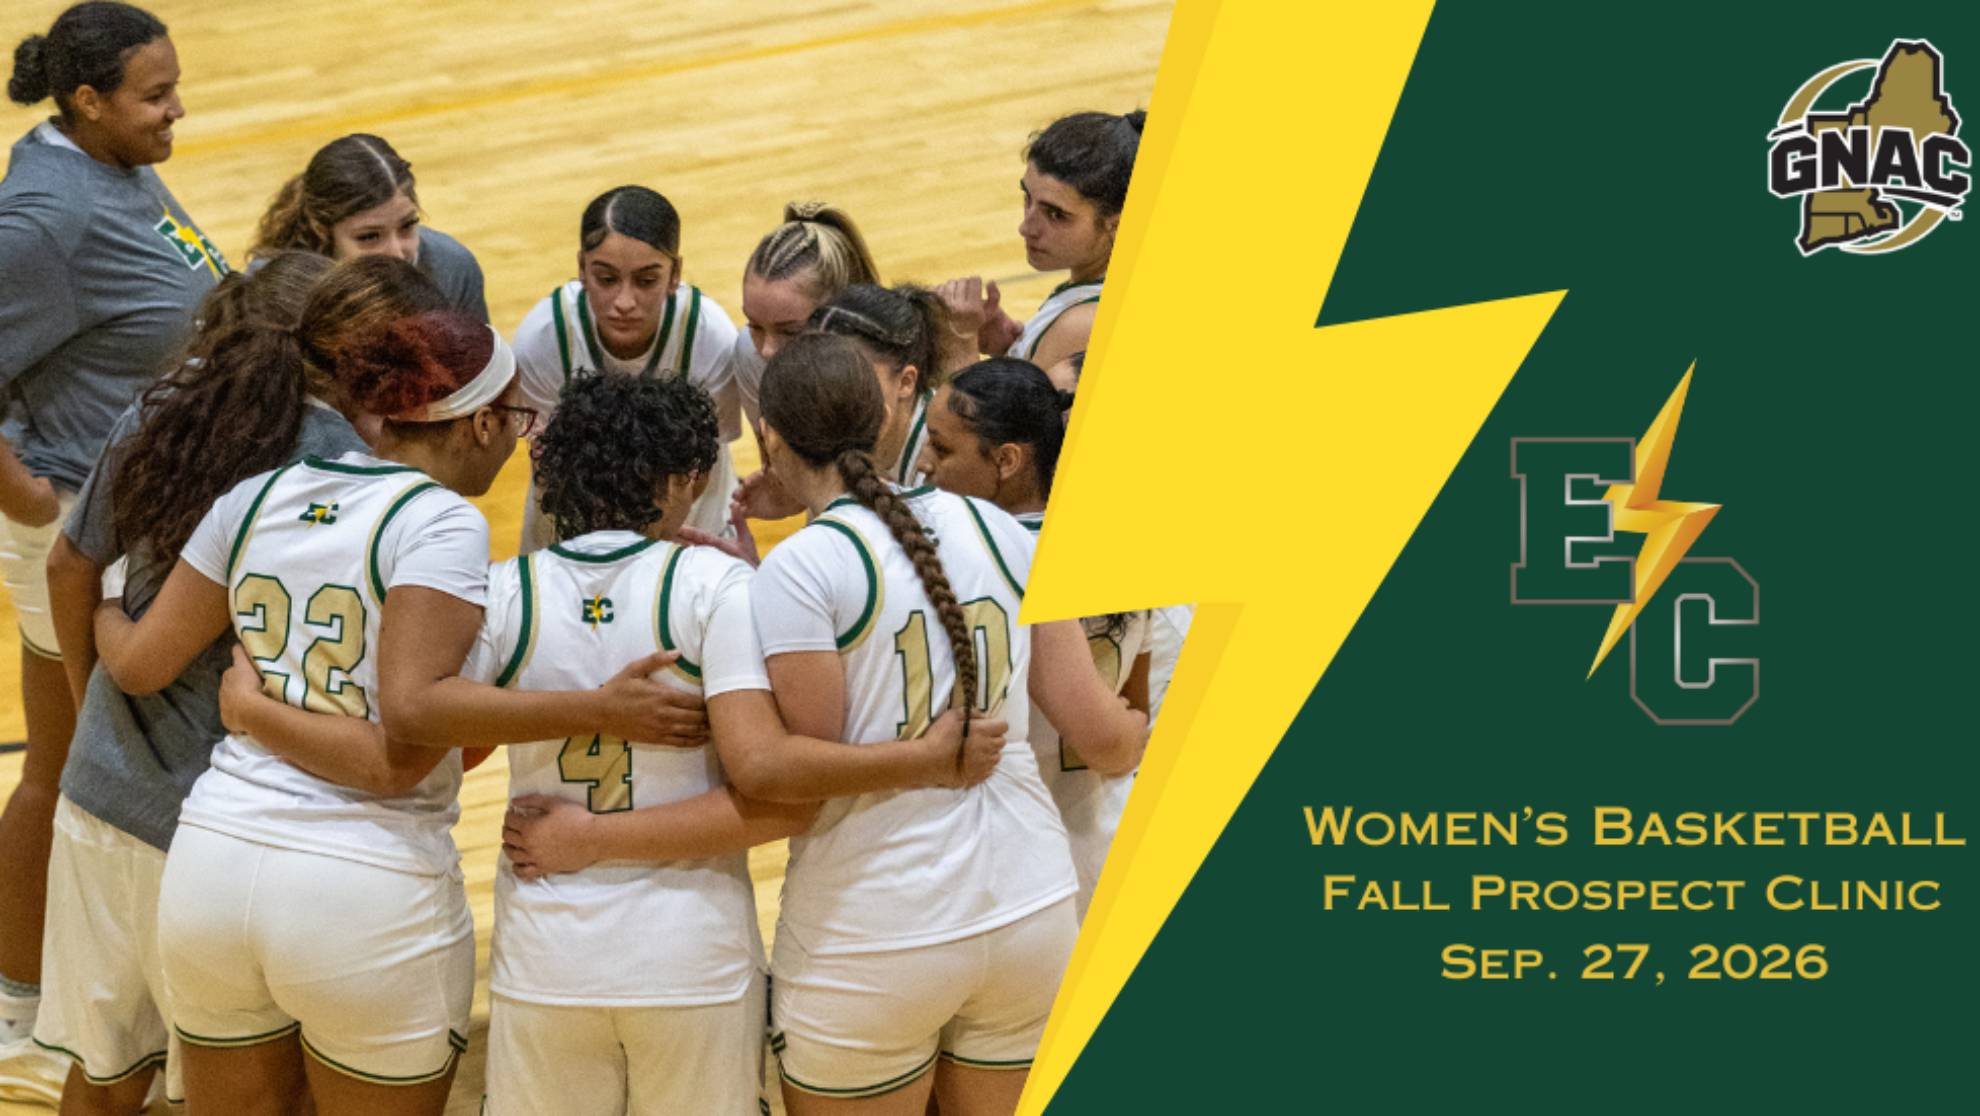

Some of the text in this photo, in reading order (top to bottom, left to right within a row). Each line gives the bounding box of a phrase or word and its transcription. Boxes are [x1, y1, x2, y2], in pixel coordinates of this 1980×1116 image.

[235, 573, 368, 720] 22
[581, 597, 614, 624] EC
[894, 595, 1012, 738] 10
[557, 733, 633, 814] 4
